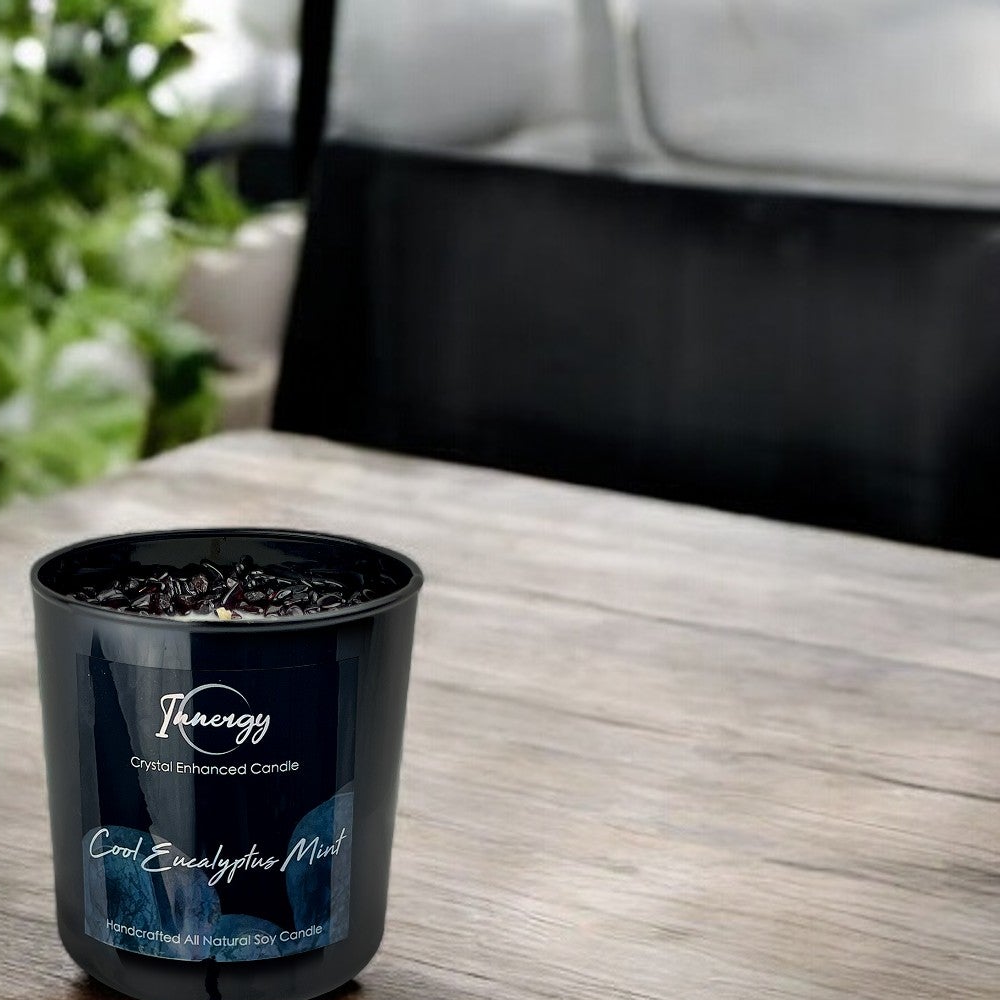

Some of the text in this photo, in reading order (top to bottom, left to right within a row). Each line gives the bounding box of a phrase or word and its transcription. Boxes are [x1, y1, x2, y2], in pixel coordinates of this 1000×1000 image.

[155, 693, 271, 745] Innergy
[130, 756, 300, 775] Crystal Enhanced Candle
[89, 827, 348, 887] Cool Eucalyptus Mint
[106, 918, 323, 947] Handcrafted All Natural Soy Candle
